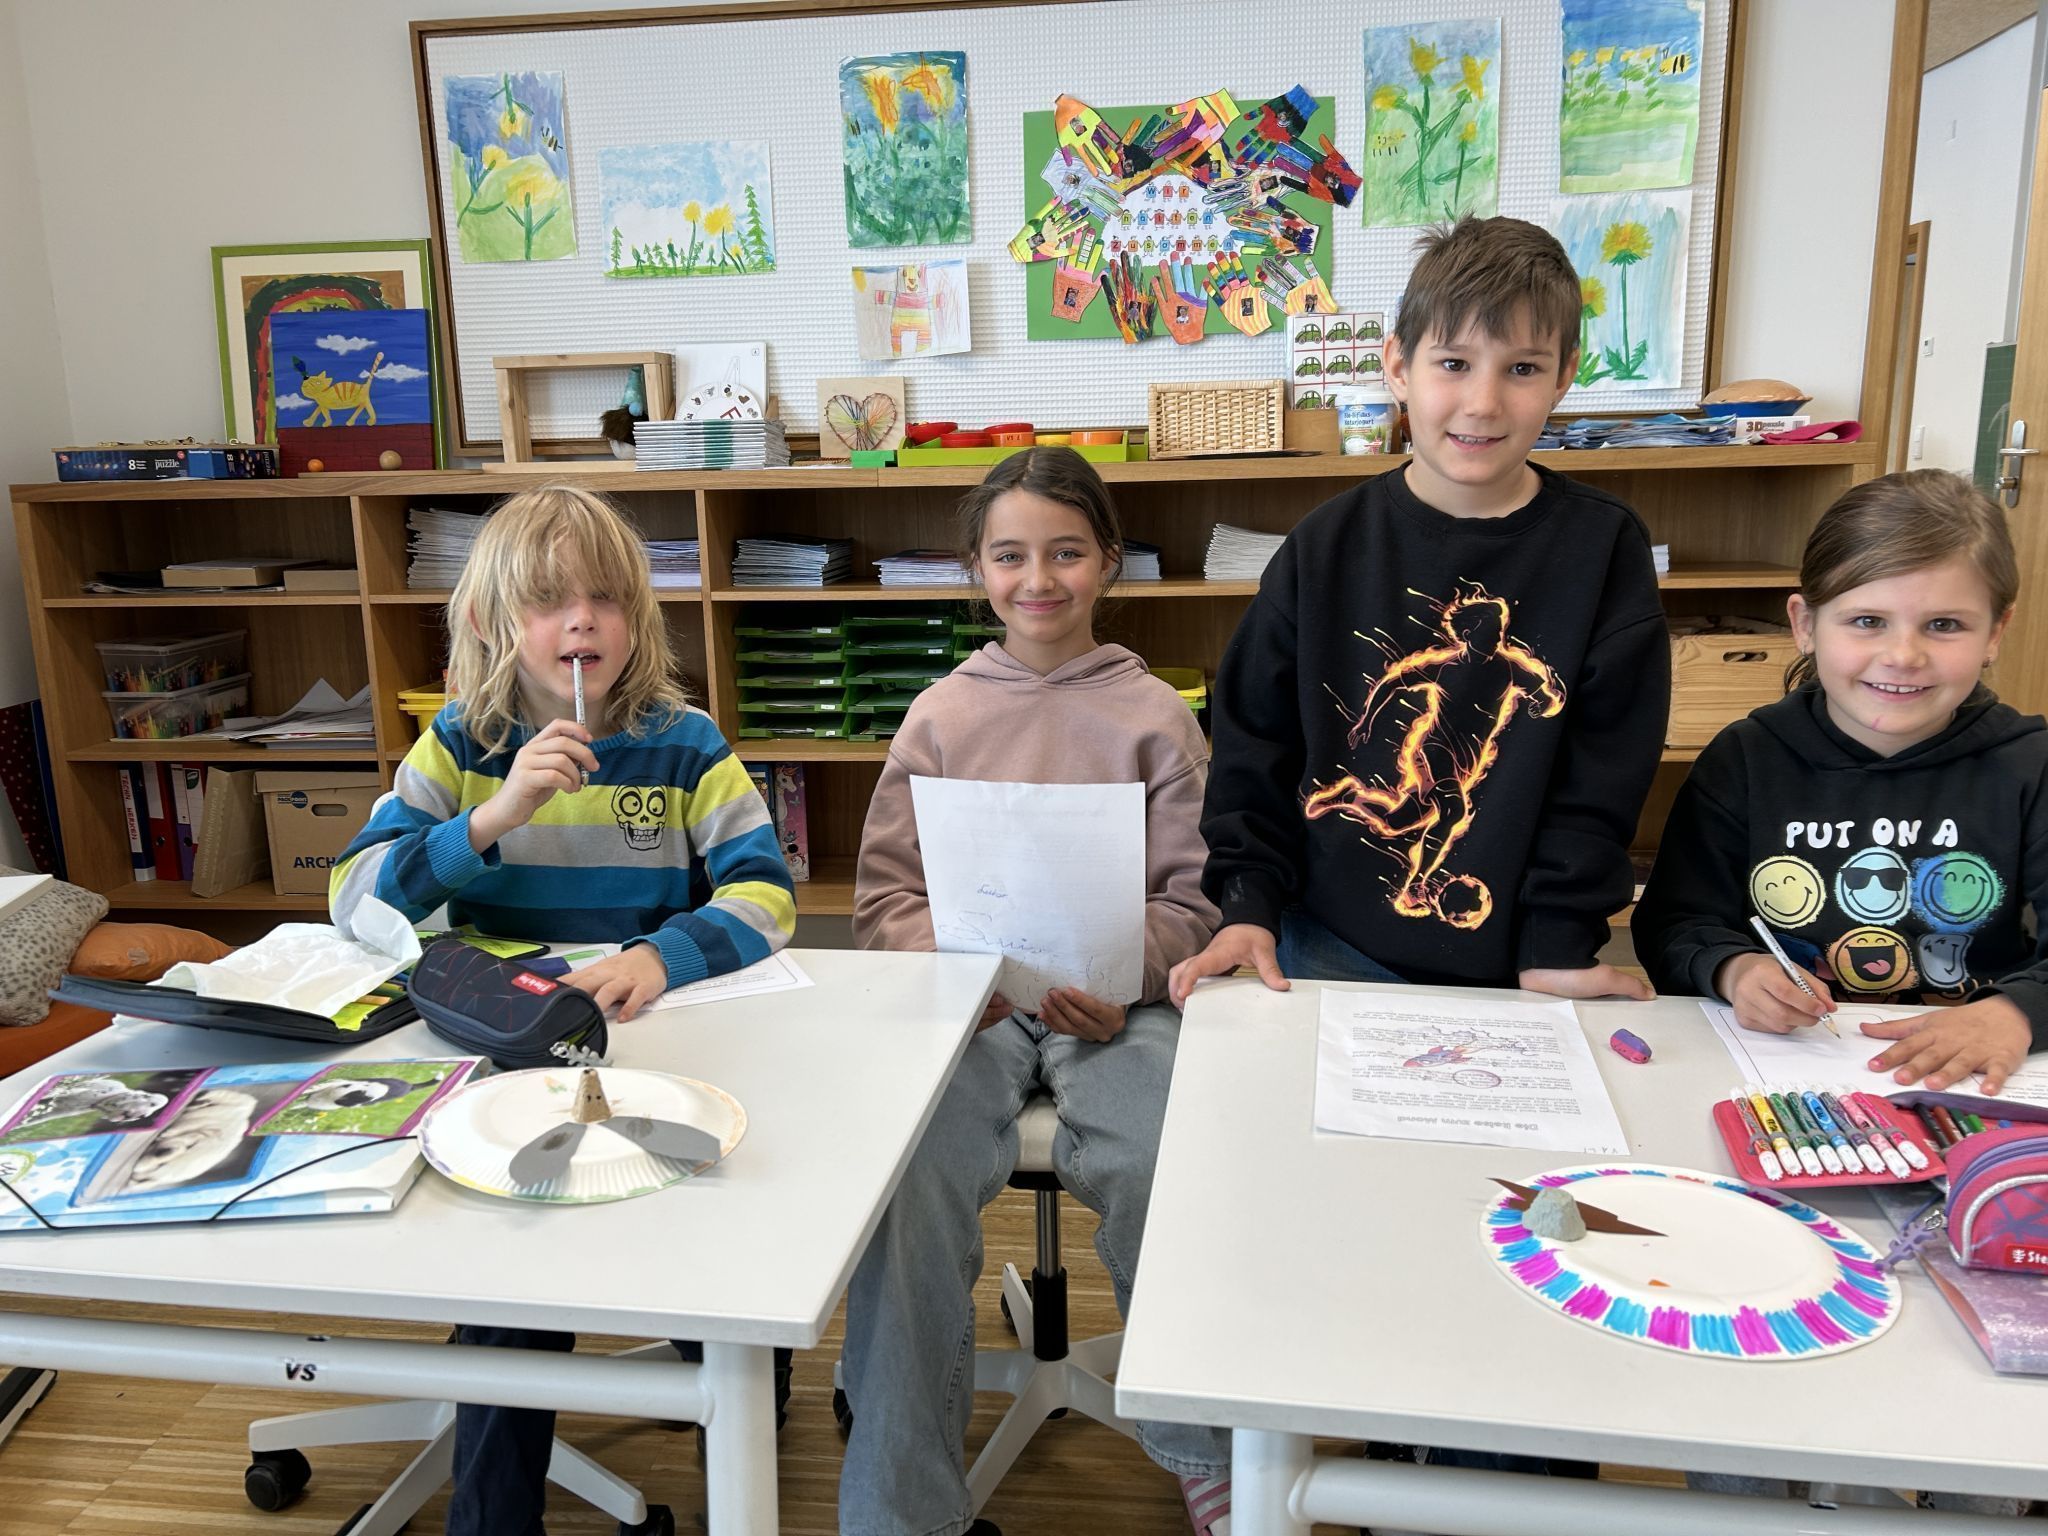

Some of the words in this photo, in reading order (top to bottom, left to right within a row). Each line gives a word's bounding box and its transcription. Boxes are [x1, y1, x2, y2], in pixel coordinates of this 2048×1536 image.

[1746, 421, 1762, 432] 3D
[128, 459, 137, 470] 8
[155, 459, 180, 470] puzzle
[1786, 820, 1855, 849] PUT
[1872, 817, 1923, 848] ON
[1931, 818, 1959, 848] A
[285, 1362, 317, 1382] VS
